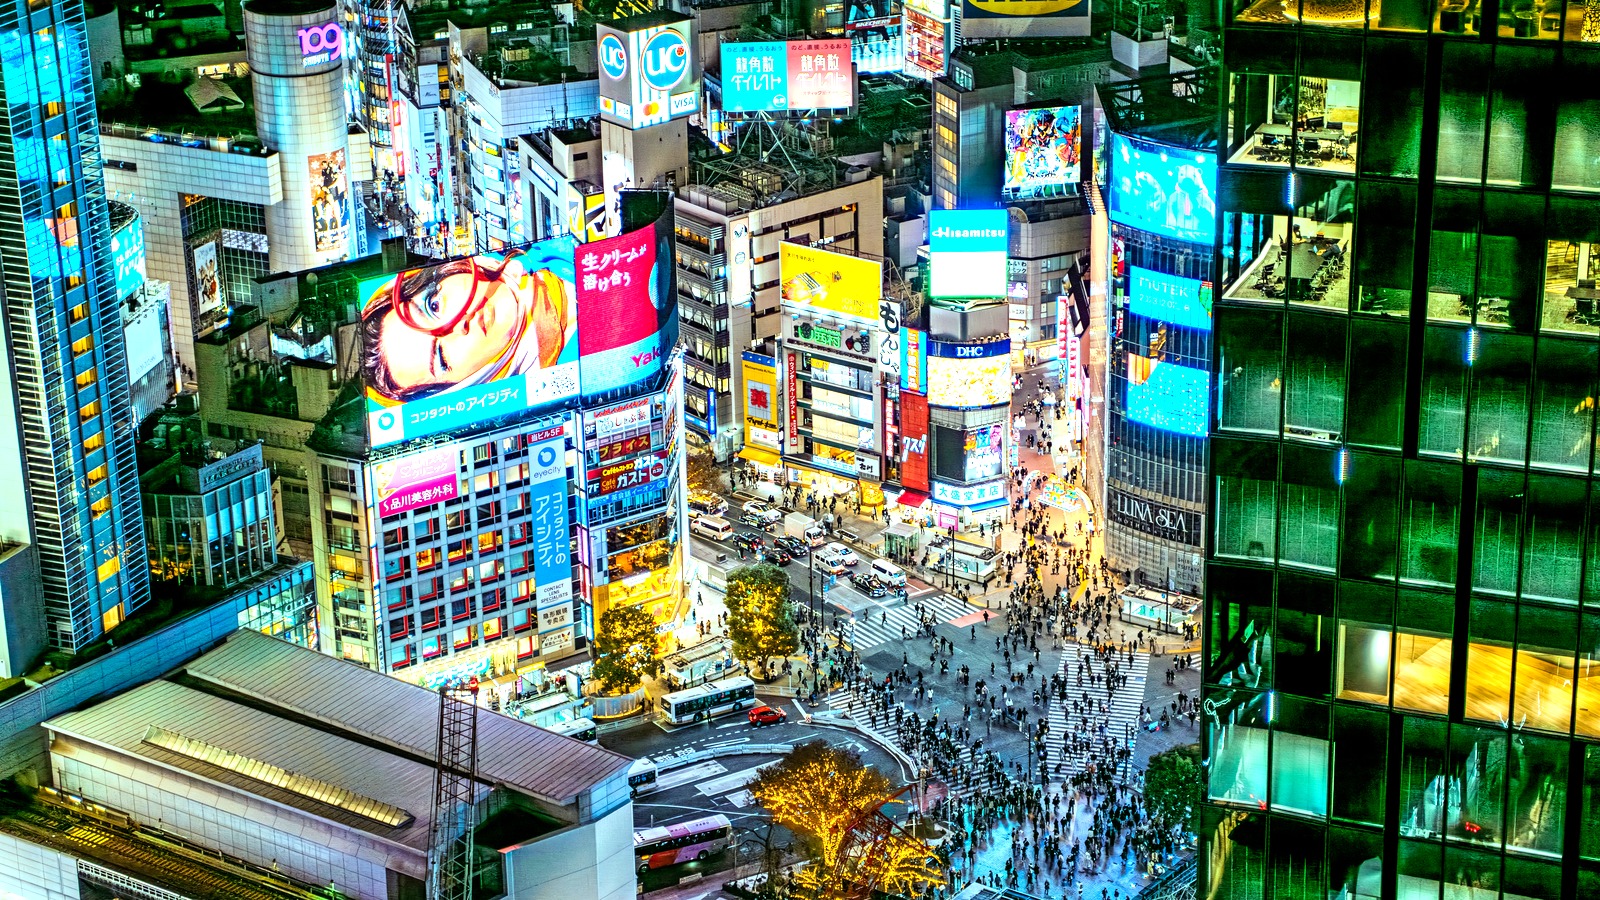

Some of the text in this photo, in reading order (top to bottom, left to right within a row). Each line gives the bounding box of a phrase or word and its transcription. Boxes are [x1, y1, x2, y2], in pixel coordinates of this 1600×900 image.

[298, 23, 342, 61] 109
[303, 52, 330, 68] SHIBUYA
[602, 44, 624, 69] UC
[646, 43, 686, 76] UC
[735, 56, 775, 73] 龍角散
[674, 97, 694, 109] VISA
[931, 226, 1006, 238] Hisamitsu
[581, 243, 647, 272] 生クリームが
[583, 269, 632, 292] 溶け合う
[956, 346, 984, 357] DHC
[585, 424, 595, 434] 9F
[533, 466, 561, 479] eyecity
[617, 470, 647, 488] ガスト
[390, 483, 453, 510] 品川美容外科
[587, 483, 600, 494] 7F
[939, 485, 999, 501] 大盛堂書店
[1117, 494, 1188, 533] LUNA SEA
[535, 495, 553, 567] アイシティ
[553, 492, 566, 564] コンタクトの
